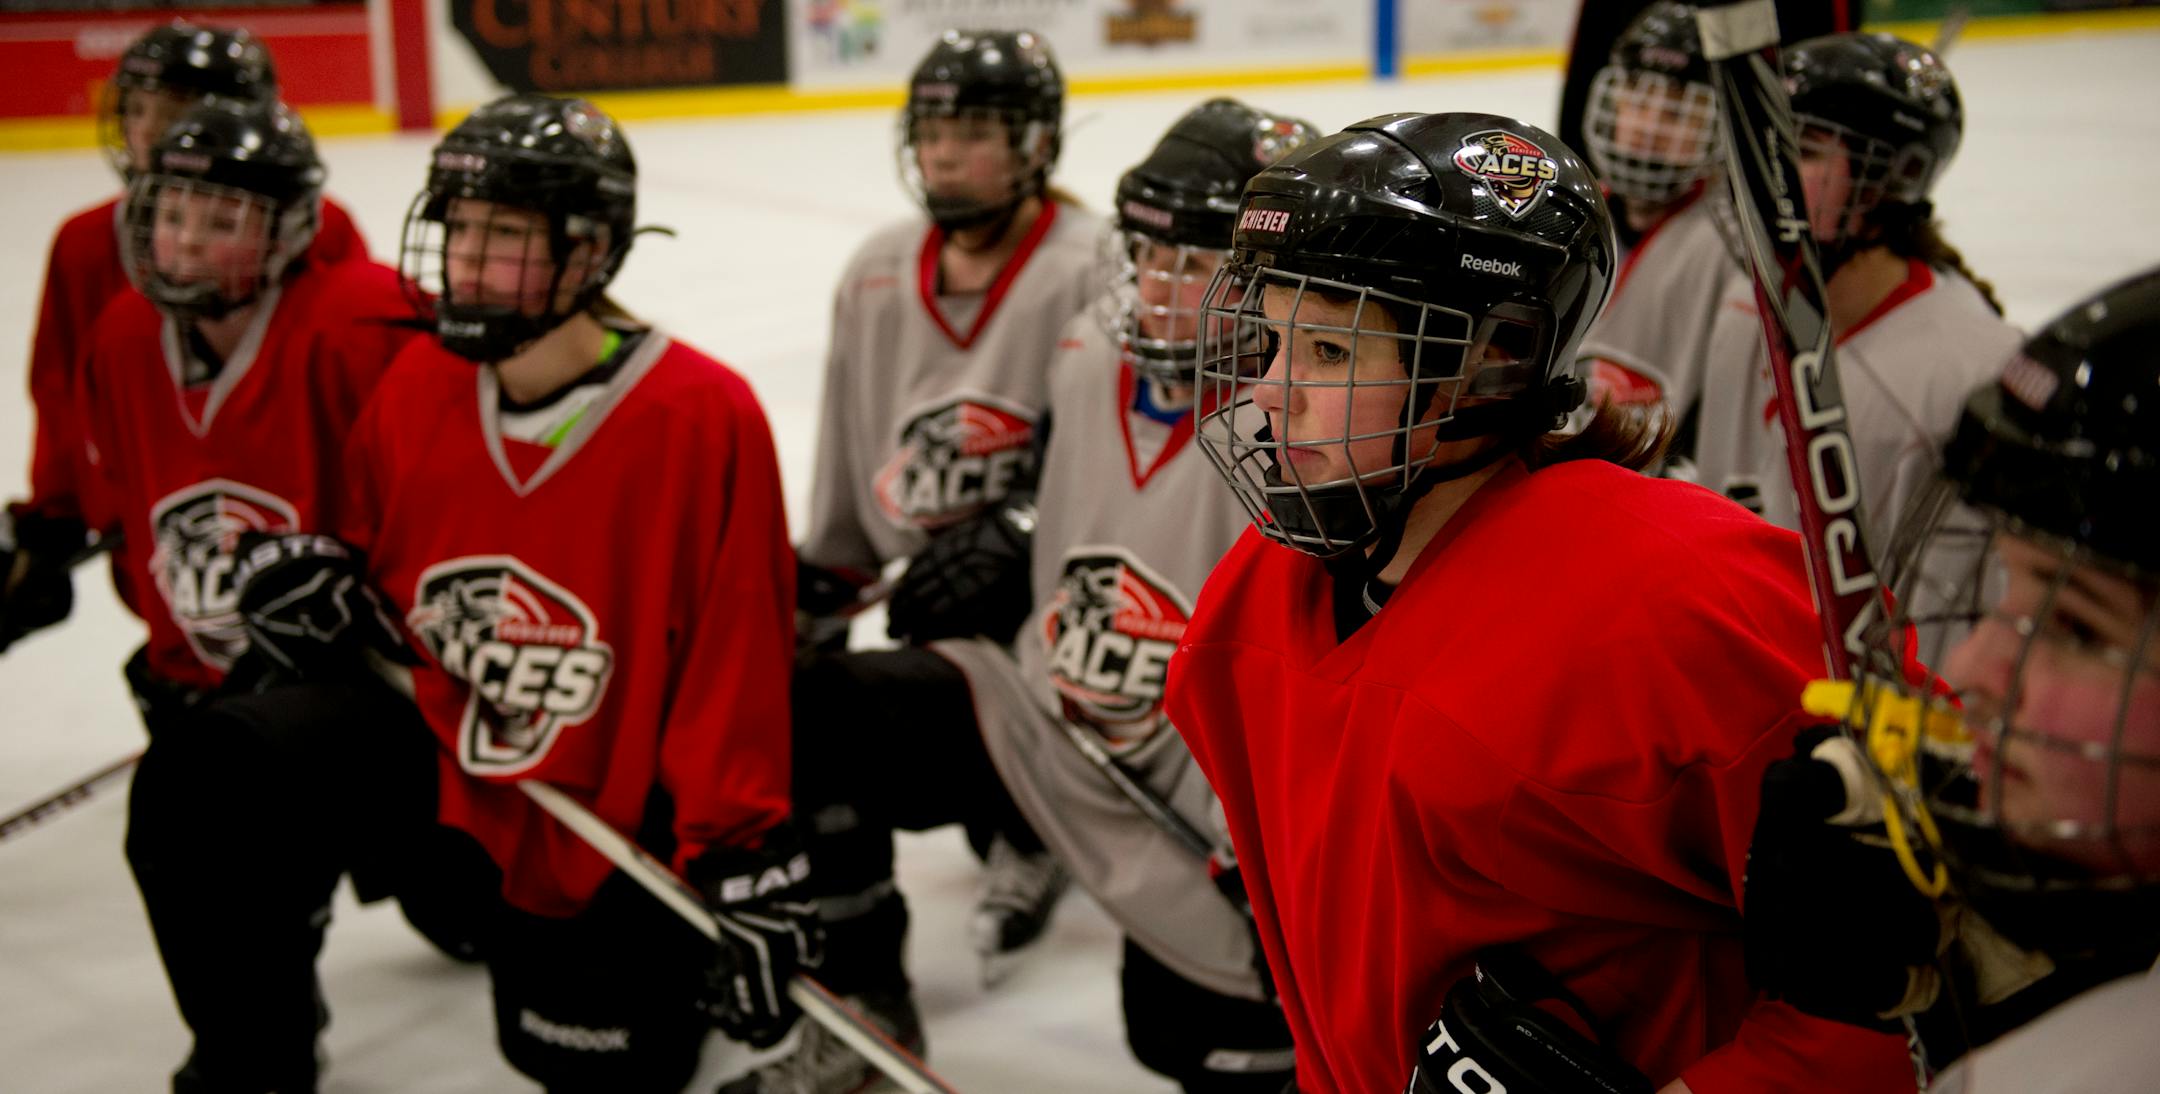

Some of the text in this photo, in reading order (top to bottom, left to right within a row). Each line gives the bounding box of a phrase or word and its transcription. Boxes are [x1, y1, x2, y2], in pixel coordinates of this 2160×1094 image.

[1477, 153, 1556, 181] ACES
[1460, 253, 1523, 277] Reebok
[902, 449, 1037, 512] ACE
[1052, 624, 1178, 700] ACE
